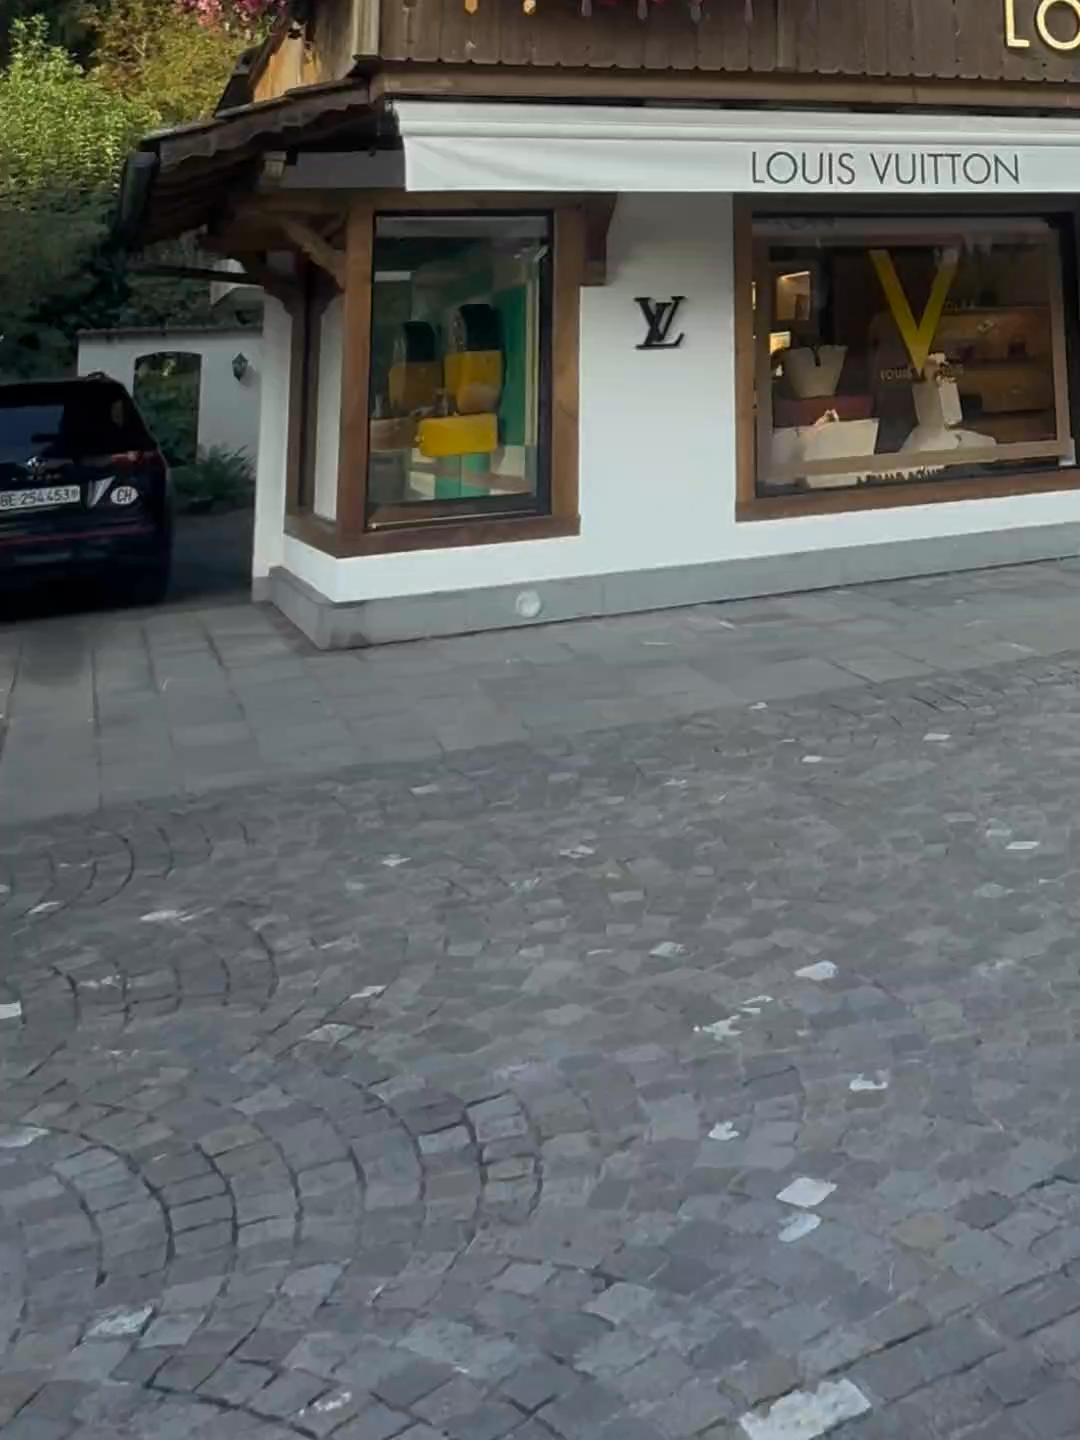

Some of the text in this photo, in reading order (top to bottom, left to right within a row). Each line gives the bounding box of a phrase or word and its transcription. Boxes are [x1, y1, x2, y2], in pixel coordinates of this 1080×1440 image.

[752, 151, 1020, 185] LOUIS VUITTON
[633, 295, 687, 350] LV
